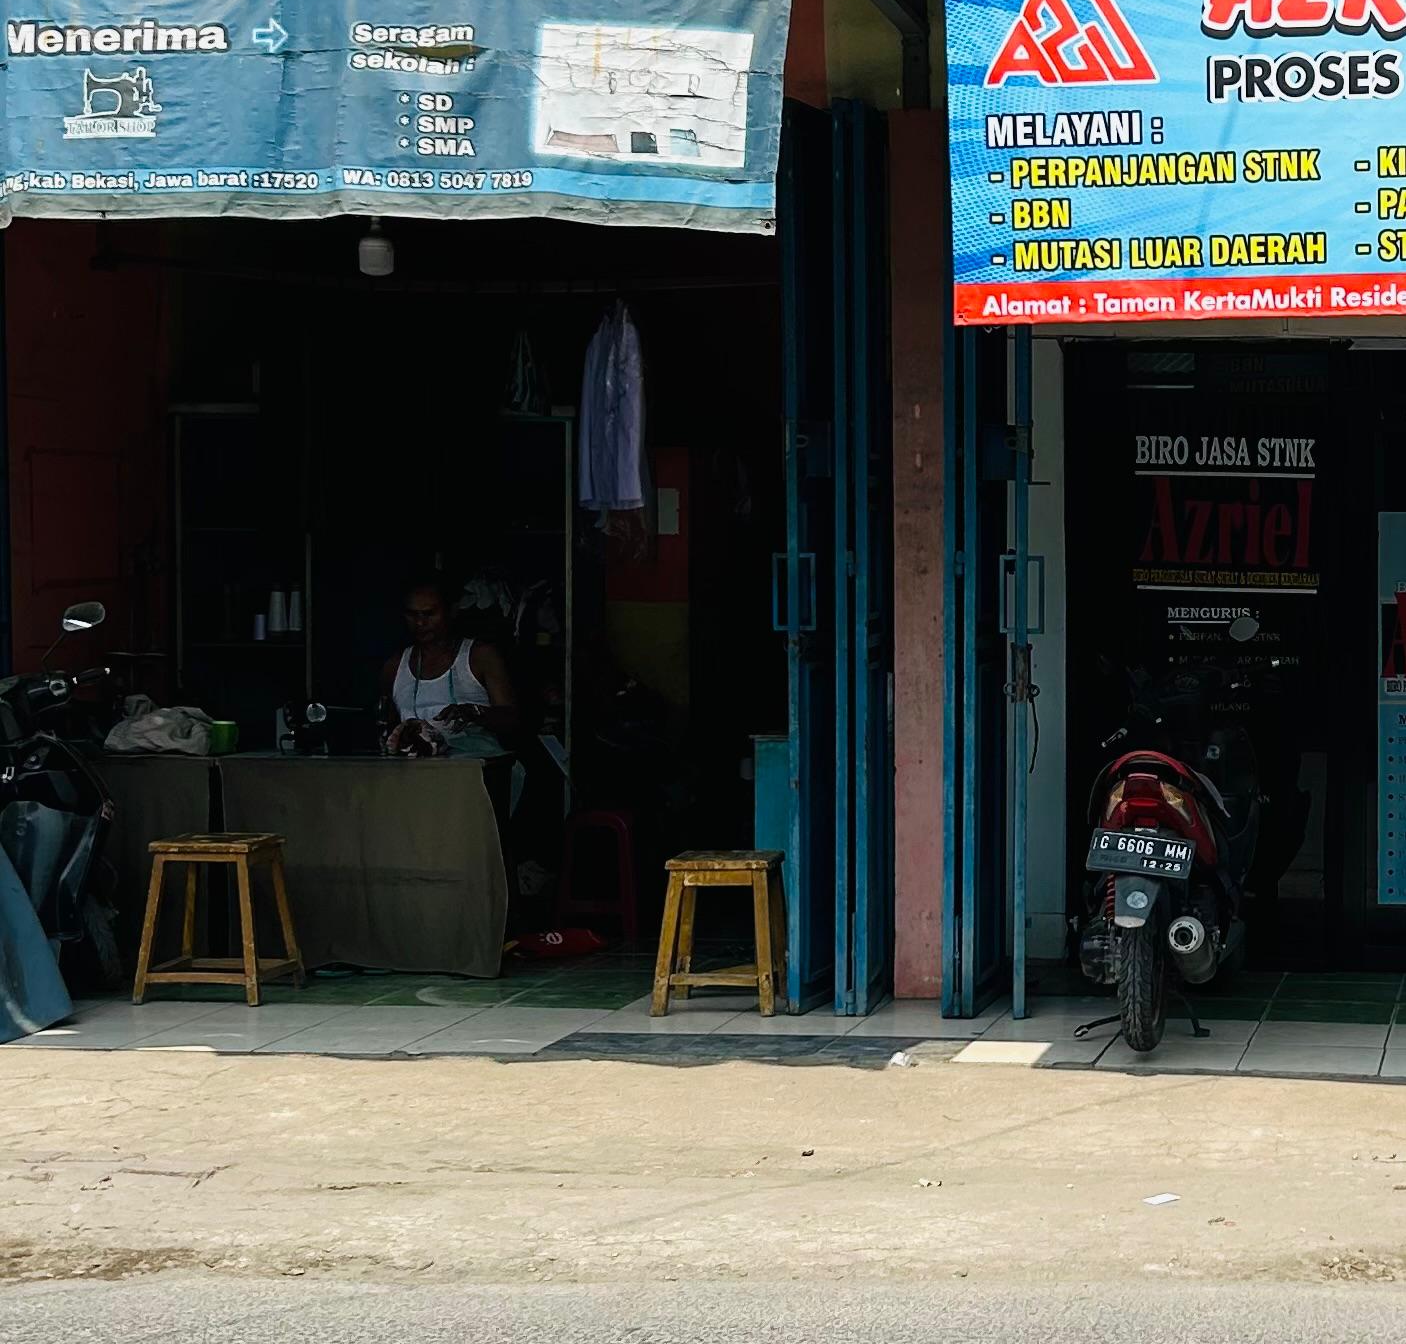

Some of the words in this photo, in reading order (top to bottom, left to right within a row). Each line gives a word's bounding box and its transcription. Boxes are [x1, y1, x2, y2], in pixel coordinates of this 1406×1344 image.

[7, 21, 228, 53] Menerima
[354, 23, 474, 46] Seragam
[1211, 52, 1401, 101] PROSES
[417, 94, 453, 112] SD
[417, 116, 475, 134] SMP
[986, 111, 1142, 148] MELAYANI
[417, 138, 476, 156] SMA
[71, 171, 140, 190] Bekasi,
[144, 172, 193, 189] Jawa
[198, 170, 247, 187] barat
[343, 169, 383, 187] WA:
[387, 171, 434, 188] 0813
[439, 173, 486, 189] 5047
[491, 171, 533, 188] 7819
[1011, 152, 1235, 188] PERPANJANGAN
[1243, 149, 1321, 182] STNK
[1011, 198, 1072, 231] BBN
[1013, 239, 1123, 272] MUTASI
[1129, 235, 1203, 268] LUAR
[1209, 231, 1327, 267] DAERAH
[983, 293, 1072, 317] Alamat
[1093, 292, 1175, 314] Taman
[1183, 286, 1322, 312] KertaMukti
[1135, 435, 1188, 464] BIRO
[1195, 437, 1251, 466] JASA
[1257, 438, 1316, 468] STNK
[1137, 475, 1312, 569] Azriel
[1167, 607, 1250, 619] MENGURUS
[1117, 837, 1155, 855] 6606
